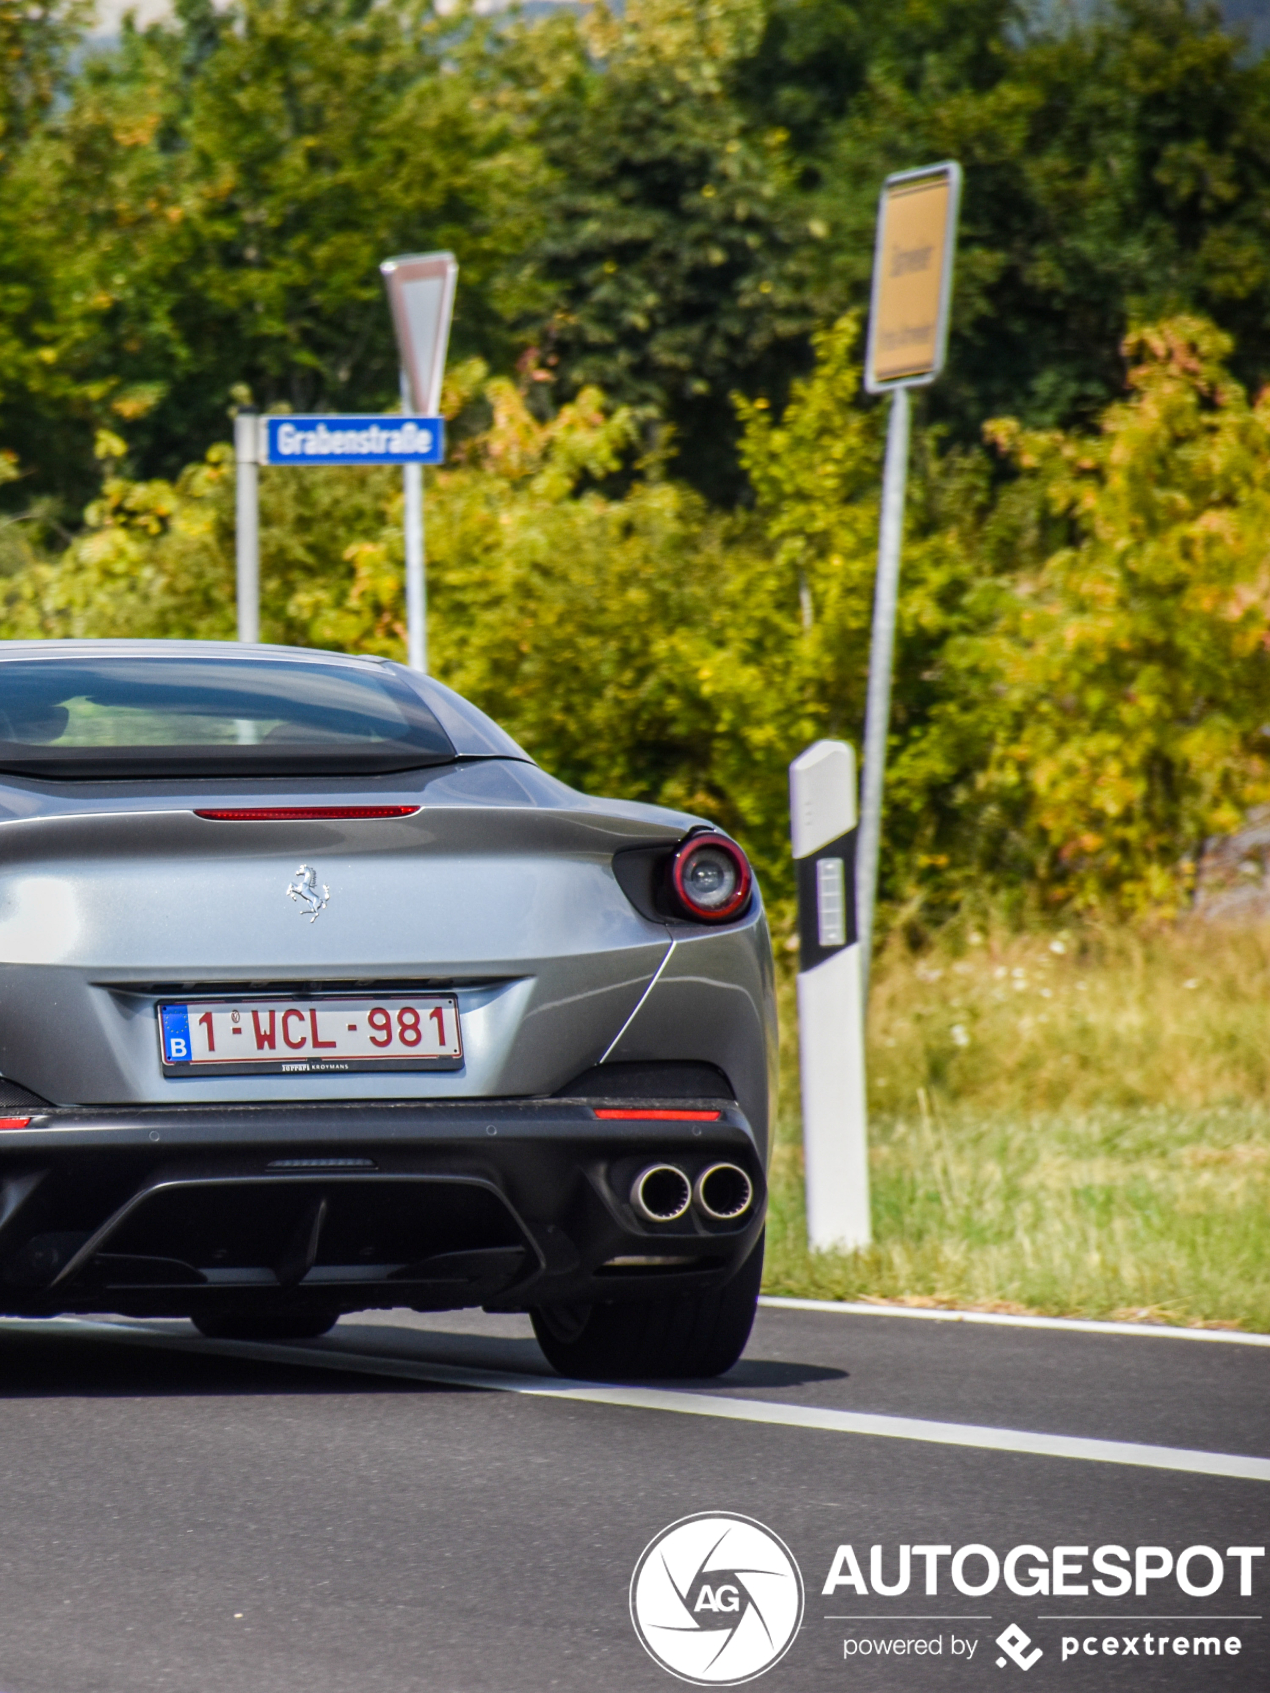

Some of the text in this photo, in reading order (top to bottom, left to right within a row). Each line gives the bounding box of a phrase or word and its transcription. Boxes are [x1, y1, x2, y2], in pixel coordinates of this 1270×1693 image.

[277, 422, 432, 454] Grabenstraße
[198, 1006, 447, 1052] 1-WCL-981
[170, 1038, 188, 1057] B
